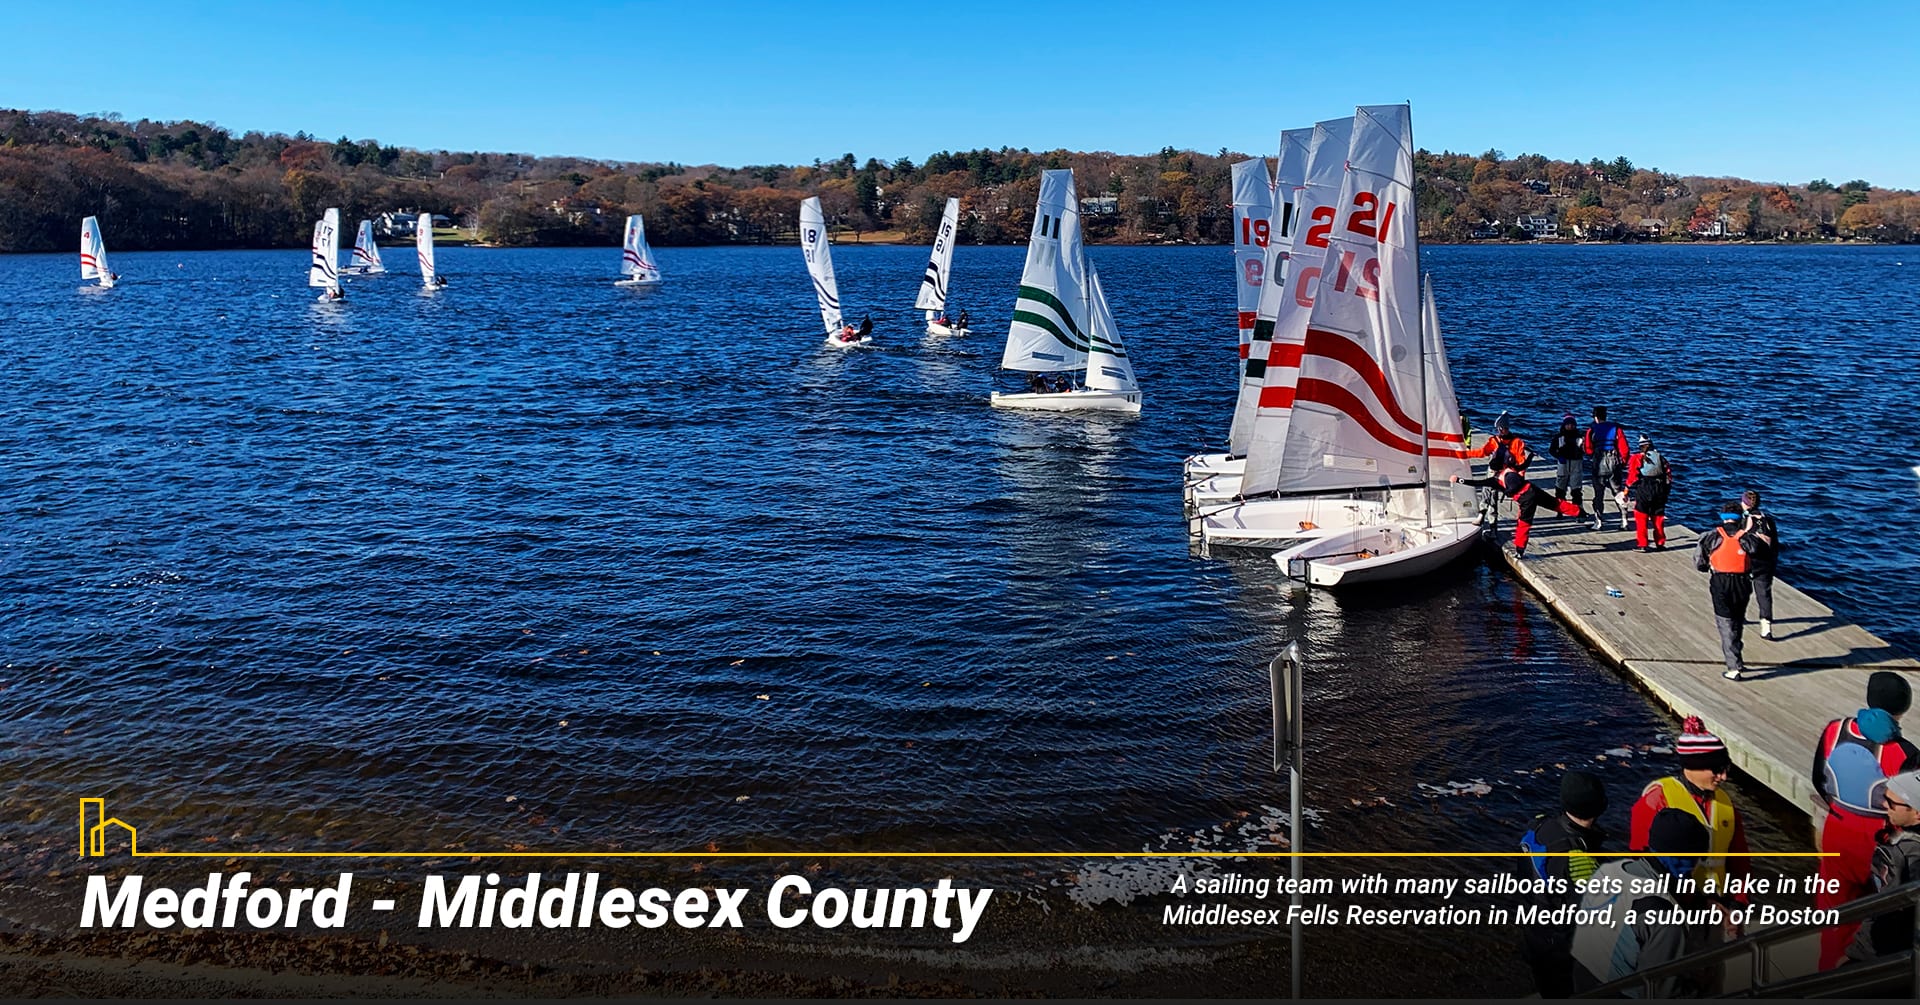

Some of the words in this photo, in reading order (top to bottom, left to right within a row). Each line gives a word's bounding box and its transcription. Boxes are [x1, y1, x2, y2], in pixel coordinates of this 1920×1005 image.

[941, 222, 952, 237] 16
[1041, 214, 1061, 239] 11
[1305, 206, 1336, 248] 2
[1347, 191, 1396, 244] 21
[323, 225, 334, 236] 17
[803, 227, 817, 244] 18
[1242, 217, 1271, 248] 19
